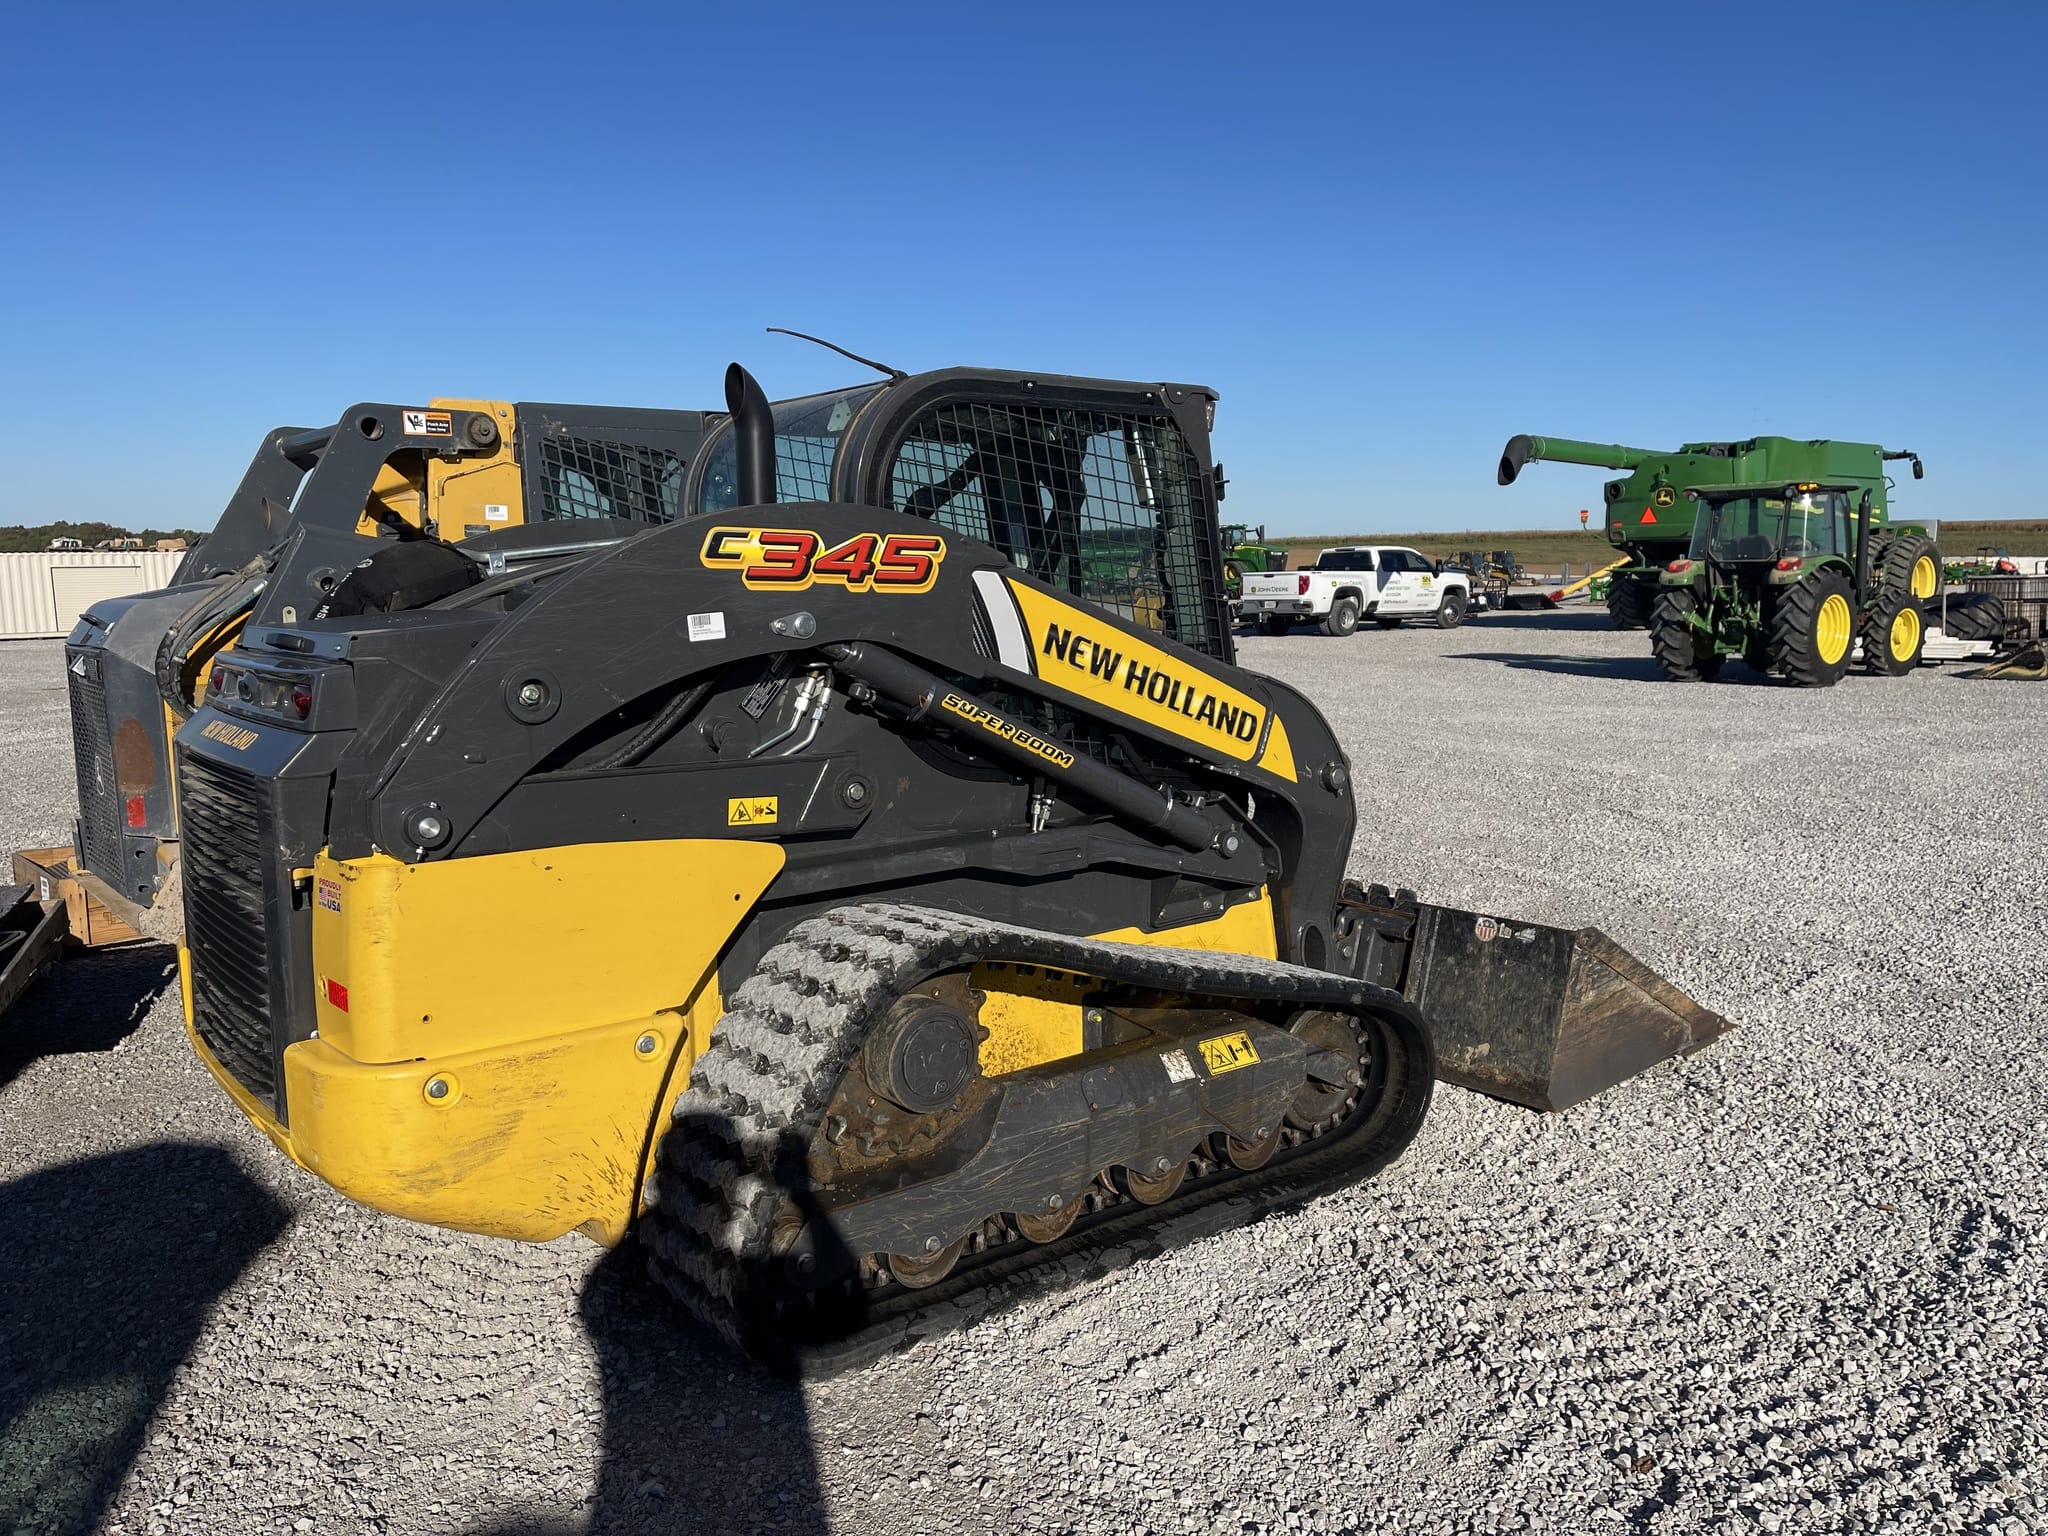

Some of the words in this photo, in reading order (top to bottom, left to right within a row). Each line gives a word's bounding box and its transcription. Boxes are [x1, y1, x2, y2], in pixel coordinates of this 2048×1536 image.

[703, 529, 944, 588] C345
[1042, 622, 1122, 682] NEW
[1124, 659, 1258, 743] HOLLAND
[214, 722, 259, 751] HOLLAND
[942, 693, 1015, 738] SUPER
[1014, 730, 1074, 767] BOOM
[319, 877, 341, 891] PROUDLY
[327, 899, 341, 912] USA
